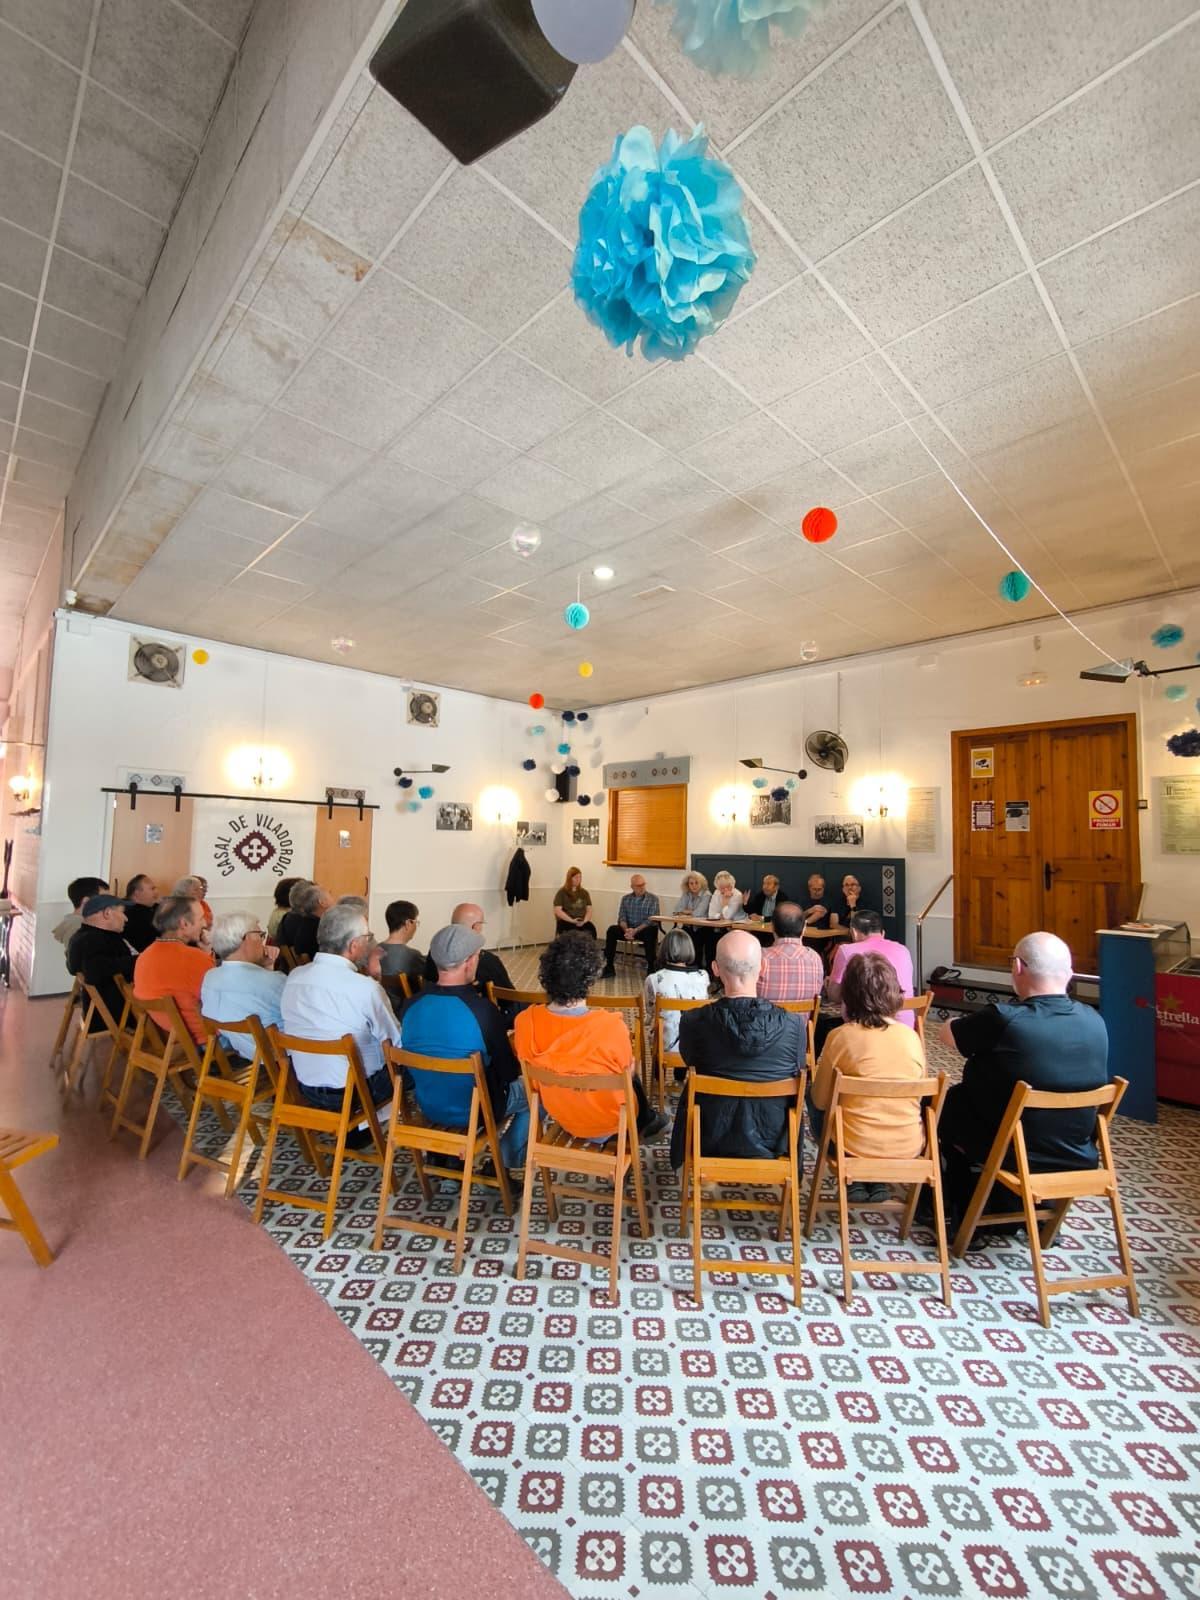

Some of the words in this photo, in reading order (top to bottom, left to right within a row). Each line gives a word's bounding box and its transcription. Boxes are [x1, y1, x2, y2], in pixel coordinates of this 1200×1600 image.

[214, 836, 235, 877] CASAL
[228, 815, 248, 833] DE
[256, 813, 294, 877] VILADORDIS
[1155, 1005, 1200, 1025] strella
